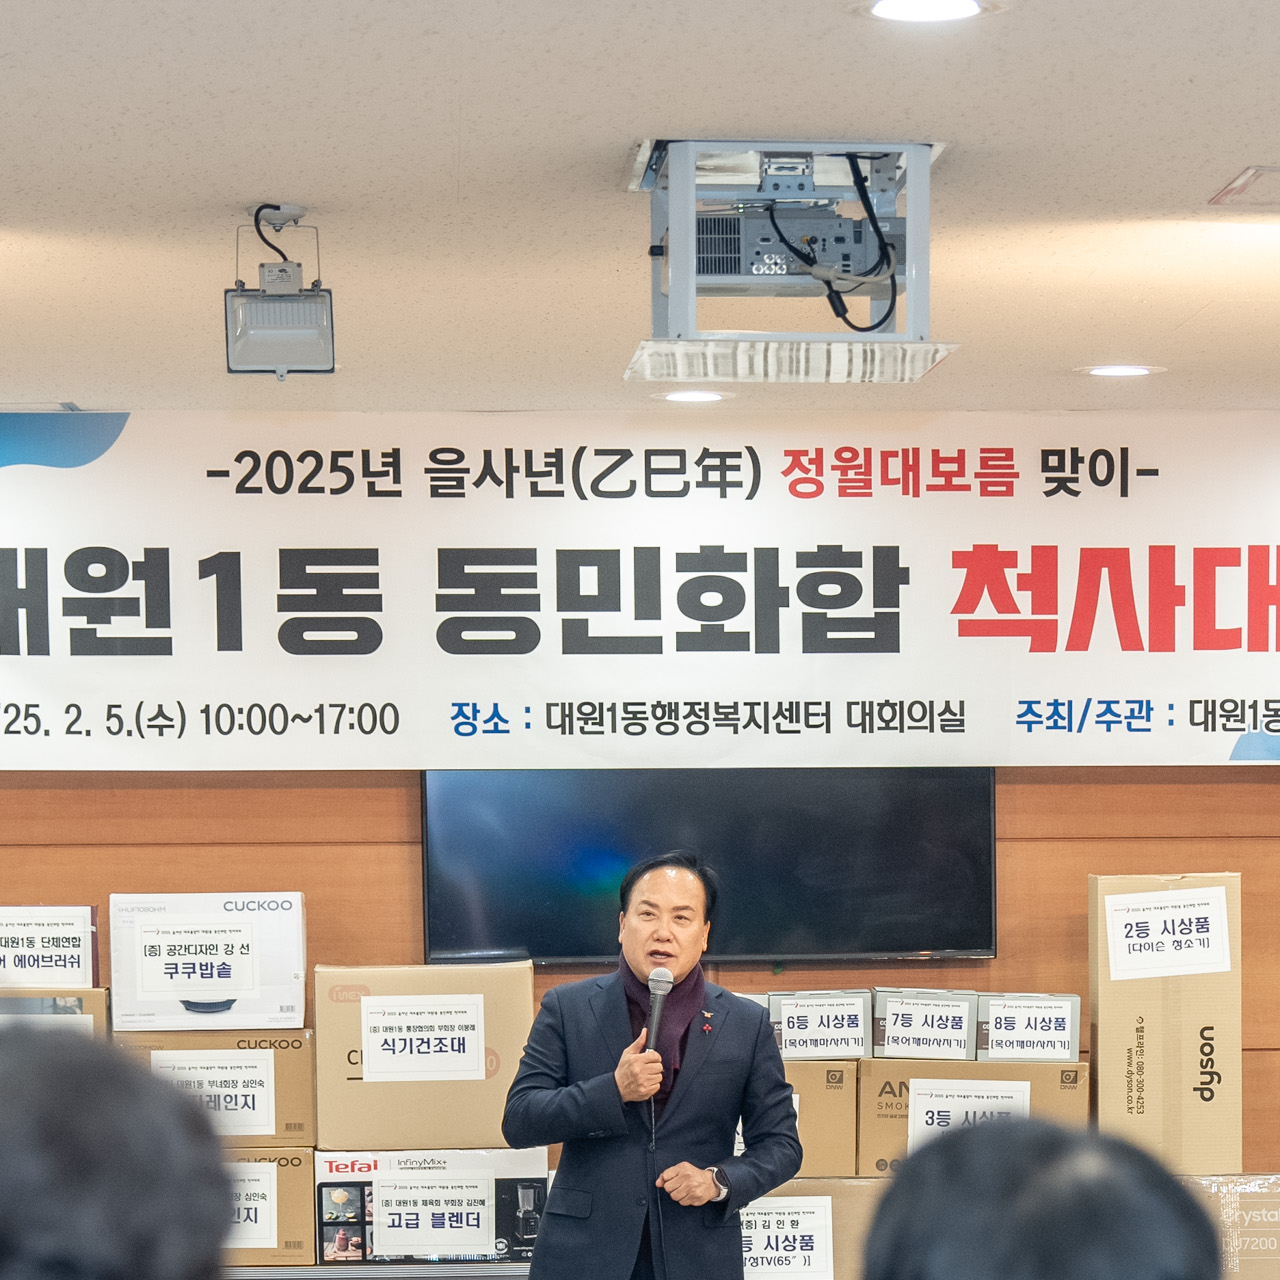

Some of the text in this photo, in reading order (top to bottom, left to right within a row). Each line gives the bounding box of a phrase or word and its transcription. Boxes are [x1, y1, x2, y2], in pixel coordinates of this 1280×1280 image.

[206, 447, 402, 498] -2025년
[780, 446, 1020, 498] 정월대보름
[1040, 446, 1160, 498] 맞이-
[434, 544, 910, 656] 동민화합
[200, 702, 400, 737] 10:00~17:00
[450, 699, 966, 737] 장소 대원1동행정복지센터 대회의실
[1015, 697, 1153, 735] 주최/주관
[223, 900, 292, 912] CUCKOO
[1124, 917, 1210, 939] 2등 시상품
[0, 936, 81, 948] 대원1동 단체연합
[166, 944, 218, 956] 공간디자인
[14, 954, 80, 968] 에어브러쉬
[164, 961, 232, 979] 쿠쿠밥솥
[787, 1014, 860, 1030] 6등 시상품
[891, 1013, 964, 1030] 7등 시상품
[994, 1016, 1067, 1032] 8등 시상품
[237, 1039, 303, 1050] CUCKOO
[381, 1036, 466, 1055] 식기건조대
[1193, 1026, 1221, 1102] dyson
[1125, 1047, 1133, 1115] www.dyson.co.kr
[1136, 1061, 1144, 1115] 080-300-4253
[925, 1110, 951, 1127] 3등
[324, 1160, 378, 1173] Tefal
[387, 1212, 481, 1229] 고급 블렌더
[764, 1234, 815, 1252] 시상품
